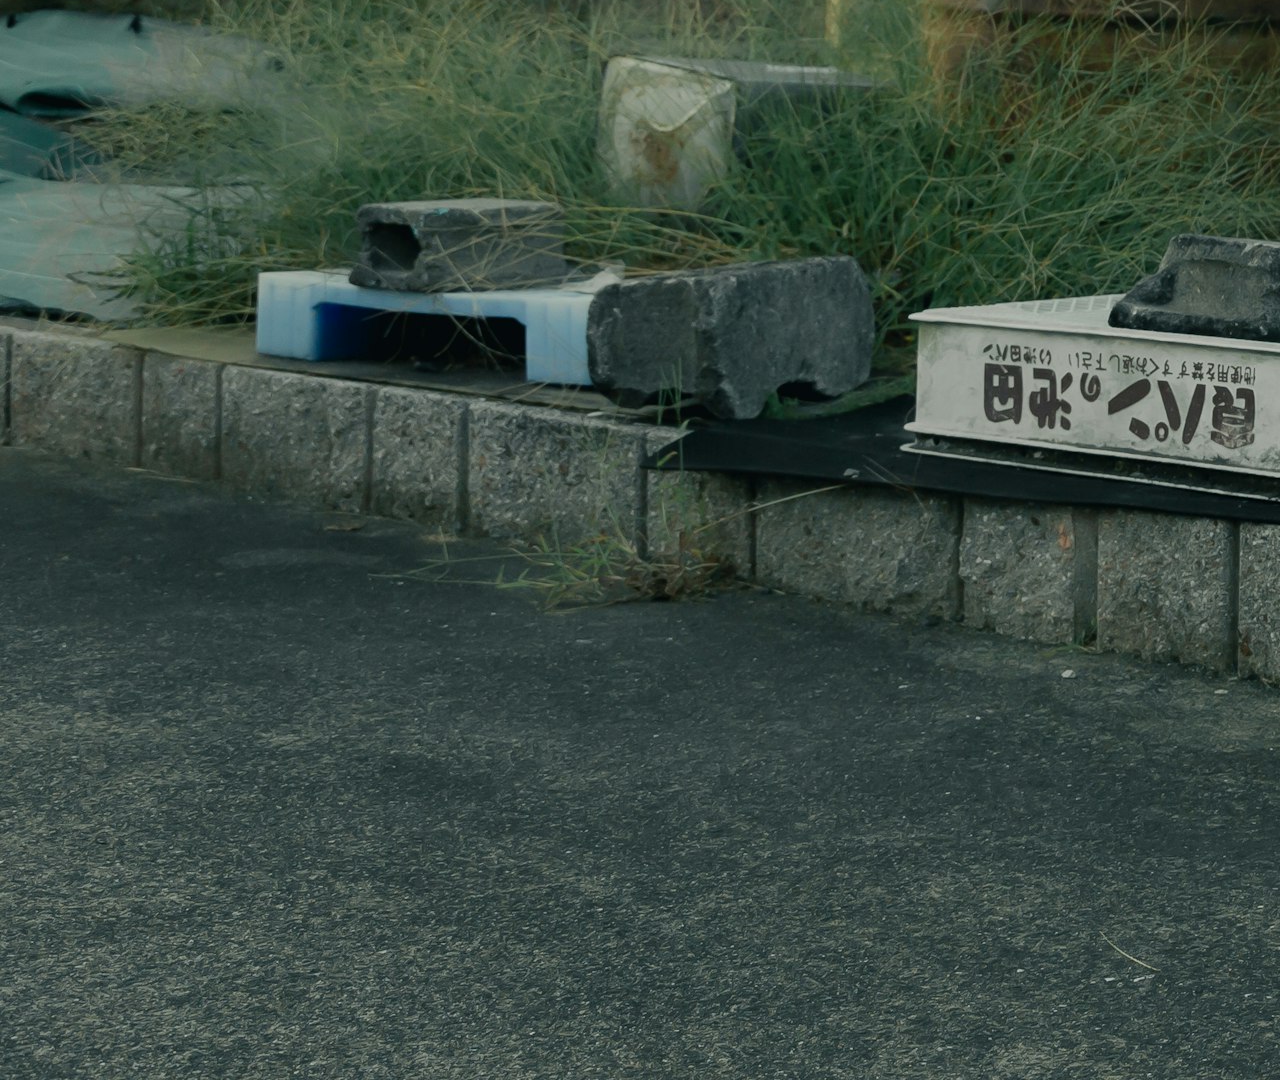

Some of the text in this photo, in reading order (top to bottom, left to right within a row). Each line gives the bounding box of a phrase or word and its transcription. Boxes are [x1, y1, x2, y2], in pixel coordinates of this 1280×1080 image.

[983, 362, 1256, 450] 食パンの池田
